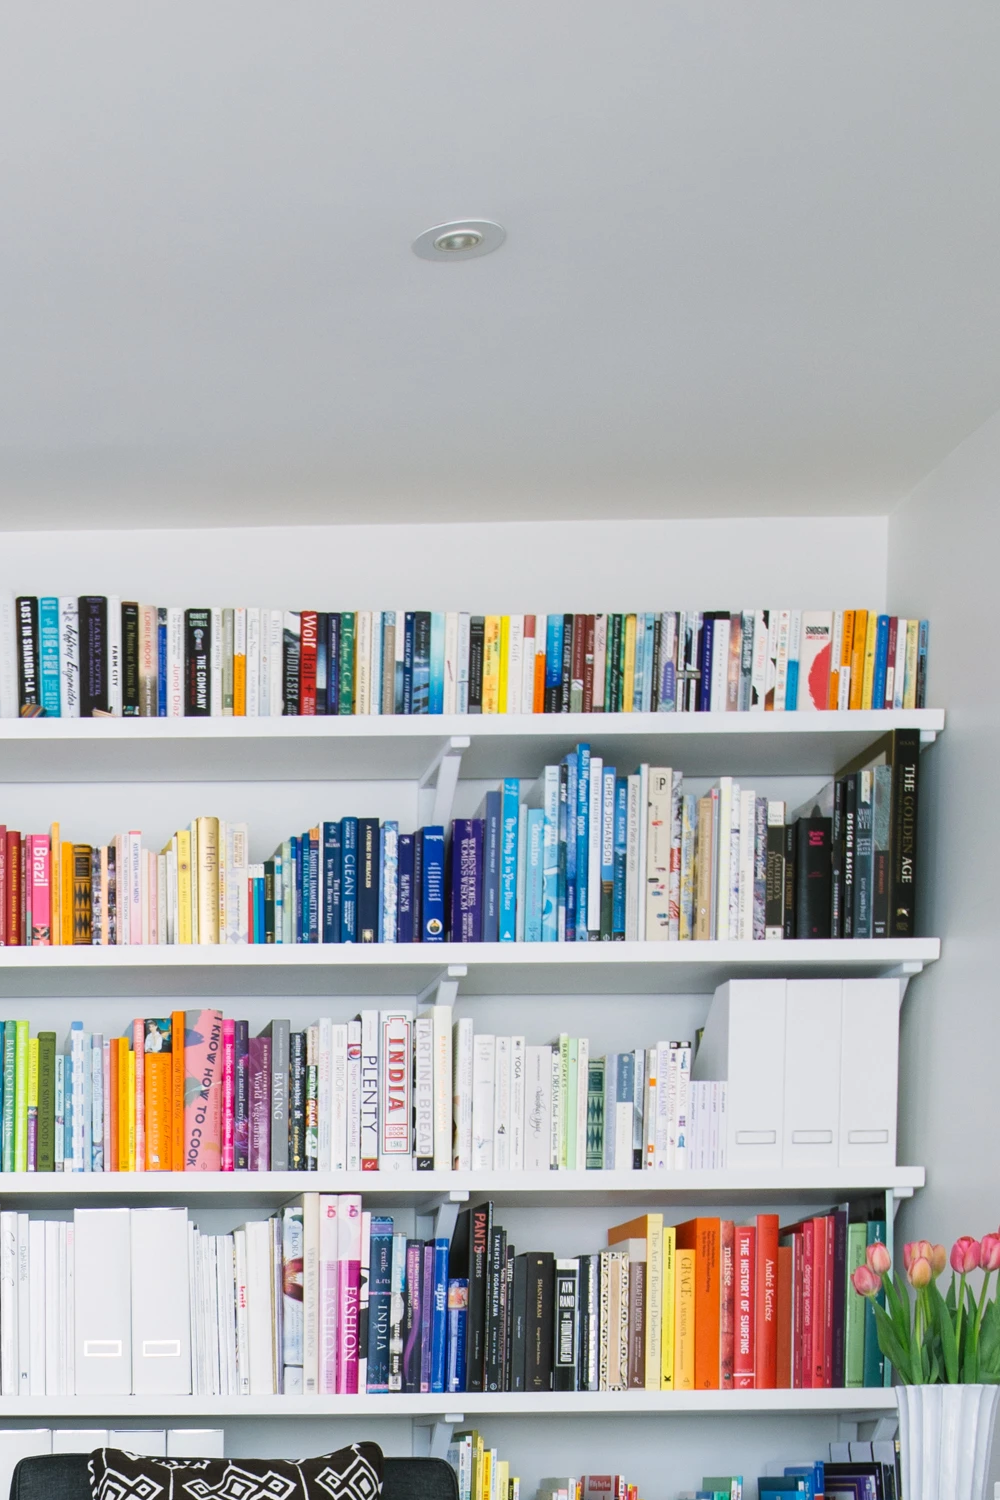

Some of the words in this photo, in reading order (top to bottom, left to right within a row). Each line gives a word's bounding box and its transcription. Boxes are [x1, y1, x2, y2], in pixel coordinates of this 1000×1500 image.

[21, 601, 31, 623] LOST
[22, 626, 32, 636] IN
[62, 625, 78, 658] Jeffrey
[271, 620, 280, 646] blink
[303, 615, 317, 648] Wolf
[806, 626, 829, 635] SHOGUN
[144, 640, 152, 669] MOORE
[196, 655, 206, 670] THE
[303, 653, 316, 679] Hall
[62, 662, 78, 706] Eugenides
[173, 664, 181, 691] Junot
[286, 647, 299, 700] MIDDLESEX
[196, 672, 206, 709] COMPANY
[605, 777, 613, 807] CHRIS
[904, 764, 915, 792] THE
[604, 810, 612, 864] JOHANSON
[903, 795, 914, 854] GOLDEN
[33, 846, 48, 887] Brazil
[204, 846, 216, 872] Help
[310, 850, 318, 879] DASHIELL
[344, 854, 355, 895] CLEAN
[902, 856, 913, 883] AGE
[767, 851, 775, 902] DAUGHTER
[774, 854, 783, 900] GALILEO'S
[310, 880, 318, 911] HAMMETT
[310, 912, 318, 929] TOUR
[207, 1024, 220, 1064] KNOW
[419, 1021, 431, 1092] TARTINE
[6, 1039, 14, 1092] BAREFOOT
[350, 1064, 359, 1085] Super
[388, 1037, 405, 1113] INDIA
[6, 1095, 13, 1106] IN
[200, 1068, 214, 1101] HOW
[254, 1072, 262, 1099] World
[274, 1072, 283, 1120] BAKING
[363, 1056, 377, 1133] PLENTY
[679, 1071, 689, 1107] LONDON
[5, 1109, 13, 1137] PARIS
[195, 1105, 207, 1124] TO
[252, 1102, 262, 1148] Vegetarian
[419, 1099, 430, 1154] BREAD
[187, 1128, 202, 1166] COOK
[350, 1116, 358, 1147] Cooking
[474, 1213, 486, 1253] PANTS
[651, 1231, 659, 1247] The
[740, 1238, 749, 1257] THE
[651, 1249, 659, 1262] Art
[651, 1264, 659, 1273] of
[723, 1246, 733, 1286] matisse
[562, 1281, 573, 1293] AYN
[680, 1257, 692, 1298] GRACE
[740, 1259, 749, 1297] HISTORY
[765, 1258, 775, 1287] André
[803, 1264, 813, 1297] designing
[560, 1295, 574, 1308] RAND
[651, 1276, 659, 1305] Richard
[740, 1300, 749, 1312] OF
[765, 1288, 774, 1322] Kertész
[323, 1287, 335, 1362] FASHION
[344, 1286, 357, 1362] FASHION
[377, 1305, 387, 1350] INDIA
[650, 1307, 659, 1357] Diebenkorn
[740, 1315, 749, 1354] SURFING
[560, 1320, 572, 1362] FOUNTAINHEAD
